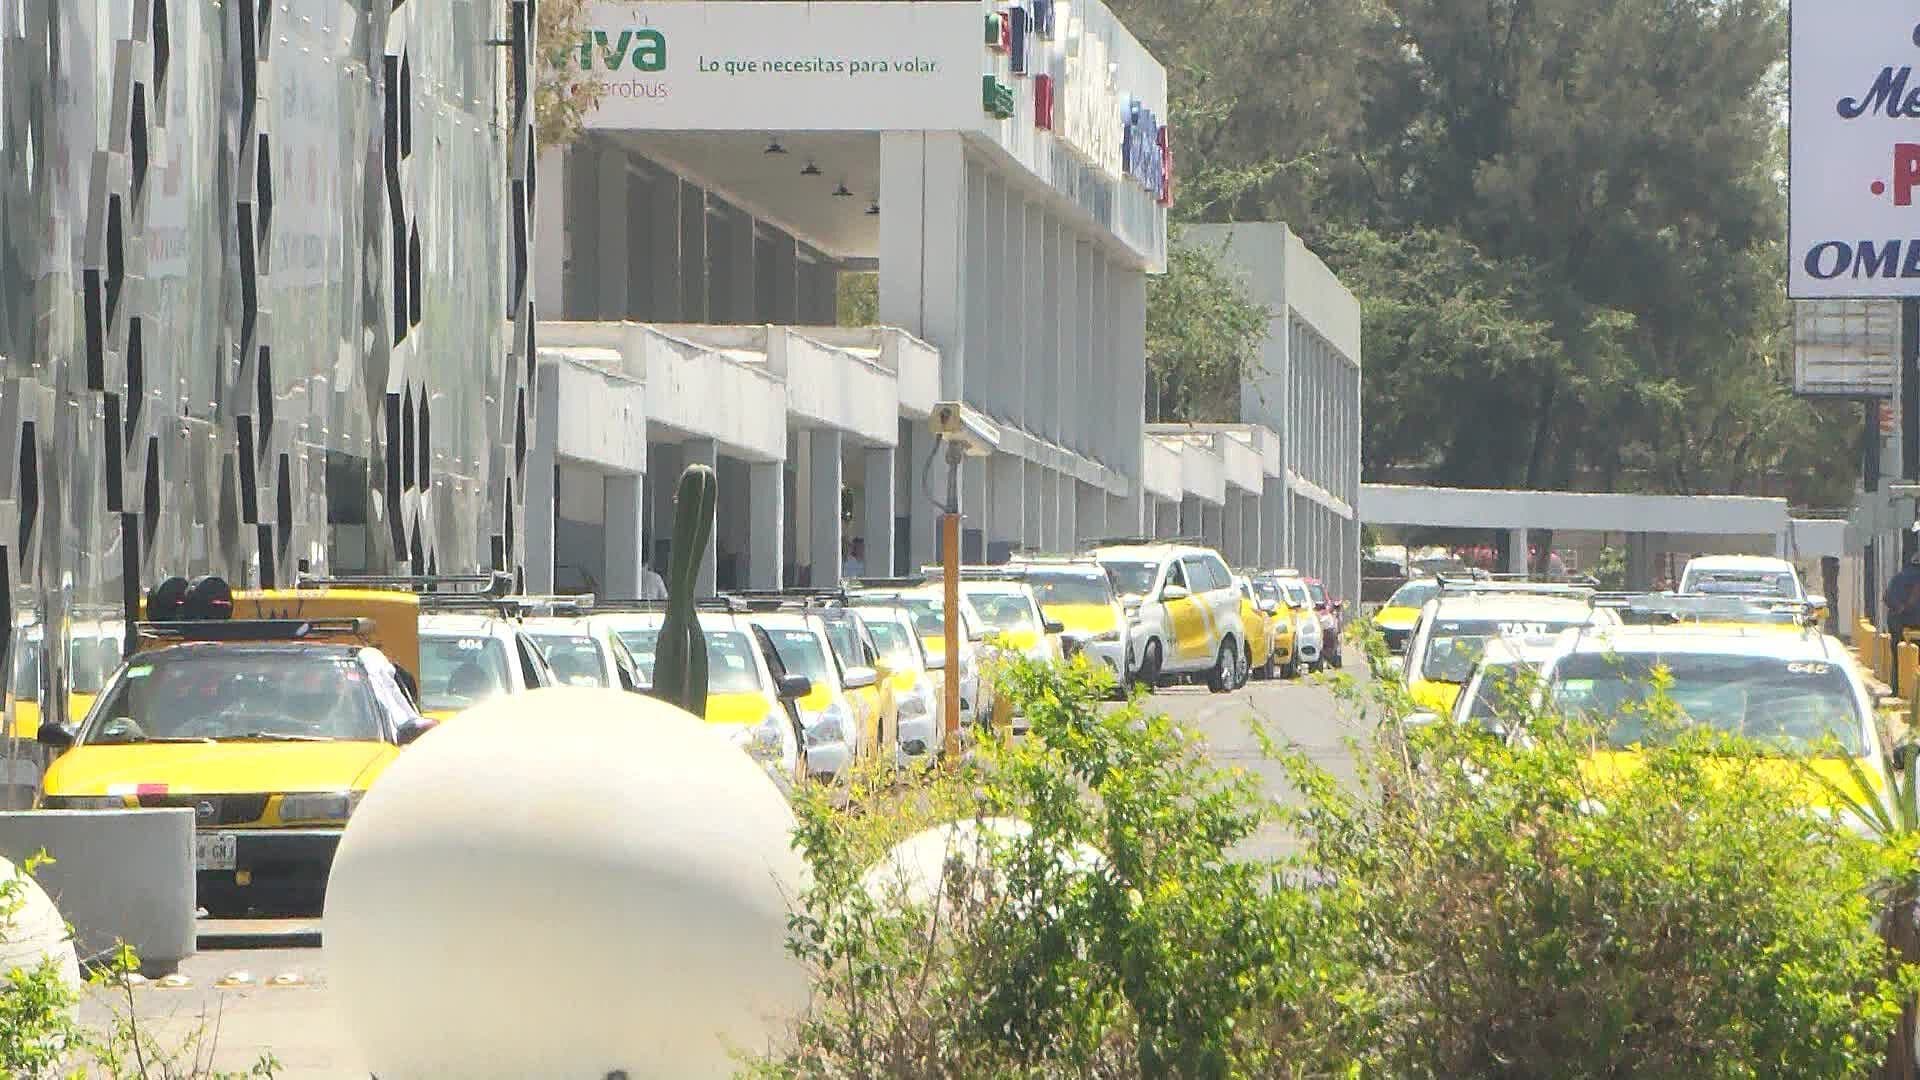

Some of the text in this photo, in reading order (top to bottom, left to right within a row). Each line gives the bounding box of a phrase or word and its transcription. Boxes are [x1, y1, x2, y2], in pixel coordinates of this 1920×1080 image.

[560, 29, 667, 72] iva
[699, 55, 720, 73] Lo
[725, 60, 757, 76] que
[762, 56, 844, 73] necesitas
[849, 60, 888, 76] para
[1498, 623, 1547, 637] TAXI
